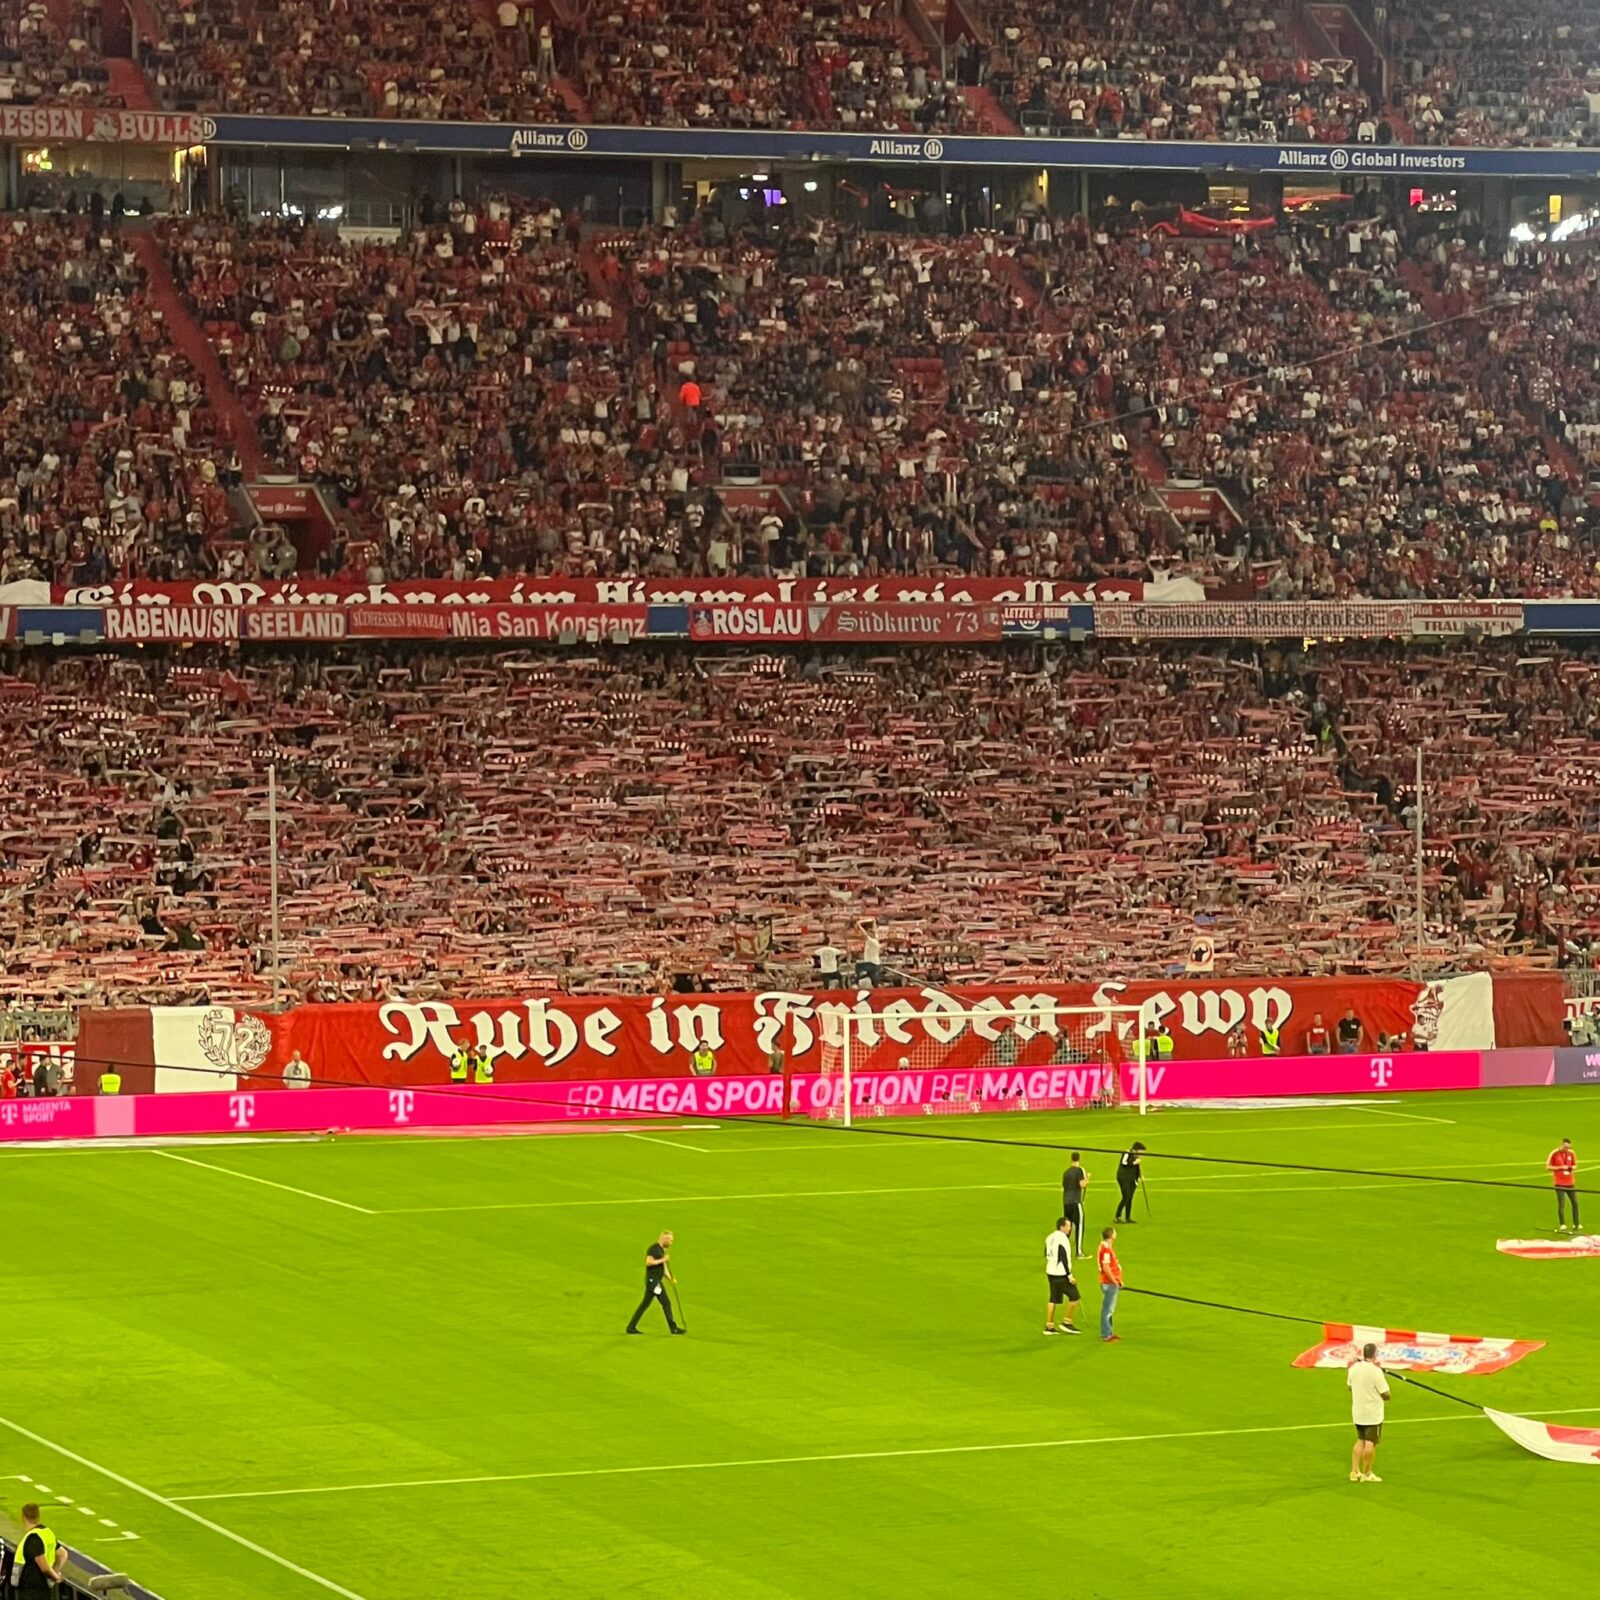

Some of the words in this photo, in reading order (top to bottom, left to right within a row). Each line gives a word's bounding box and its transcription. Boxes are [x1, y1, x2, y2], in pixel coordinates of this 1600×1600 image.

[0, 110, 83, 138] ESSEN
[119, 111, 204, 142] BULLS
[511, 130, 564, 146] Allianz
[870, 140, 920, 155] Allianz
[1278, 150, 1327, 166] Allianz
[1351, 152, 1396, 167] Global
[1401, 153, 1465, 168] Investors
[106, 607, 239, 638] RABENAU/SN
[248, 612, 345, 637] SEELAND
[452, 611, 491, 637] Mia
[496, 611, 539, 637] San
[545, 611, 647, 639] Konstanz
[712, 606, 801, 635] RÖSLAU
[837, 611, 942, 633] Südkurve
[947, 612, 979, 633] '73
[1134, 609, 1236, 627] Commando
[378, 997, 622, 1066] Ruhe
[646, 997, 725, 1055] in
[753, 987, 1059, 1056] Frieden
[610, 1082, 698, 1115] MEGA
[705, 1079, 806, 1112] SPORT
[810, 1075, 924, 1108] OPTION
[930, 1073, 975, 1103] BEI
[1128, 1066, 1165, 1096] TV
[22, 1101, 71, 1113] MAGENTA
[23, 1112, 54, 1124] SPORT
